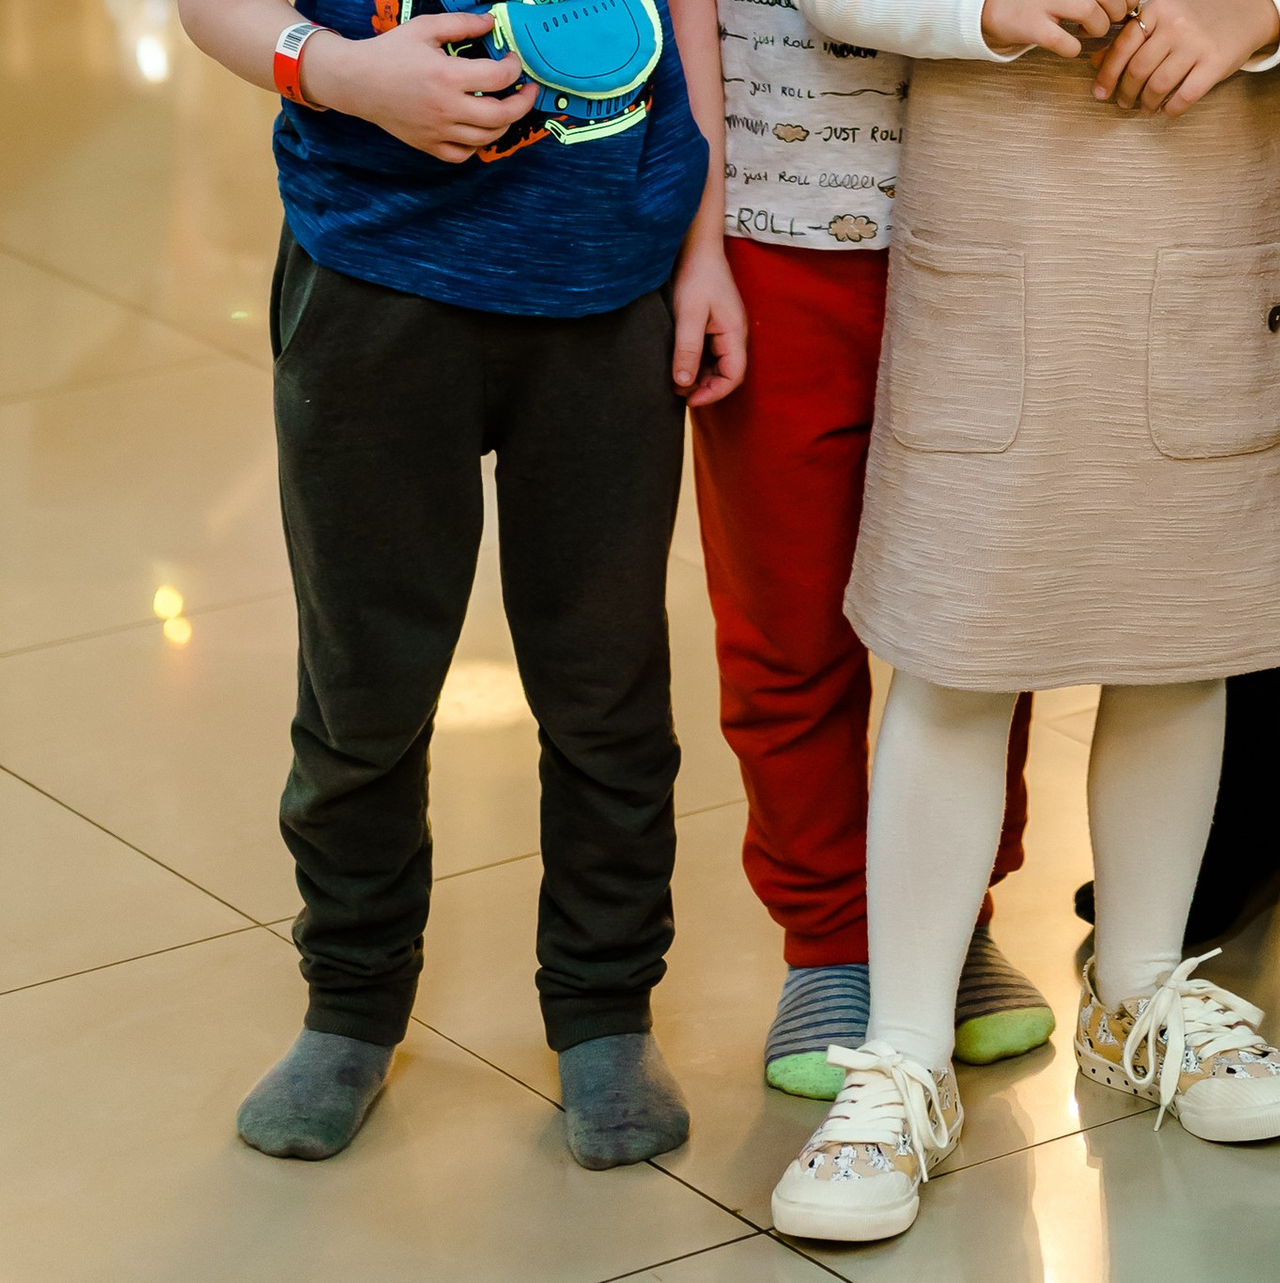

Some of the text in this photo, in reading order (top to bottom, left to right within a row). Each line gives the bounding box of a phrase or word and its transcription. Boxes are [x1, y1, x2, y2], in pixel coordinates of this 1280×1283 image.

[783, 37, 815, 49] ROLL
[780, 86, 816, 99] ROLL
[778, 171, 811, 186] ROLL
[736, 207, 806, 236] ROLL
